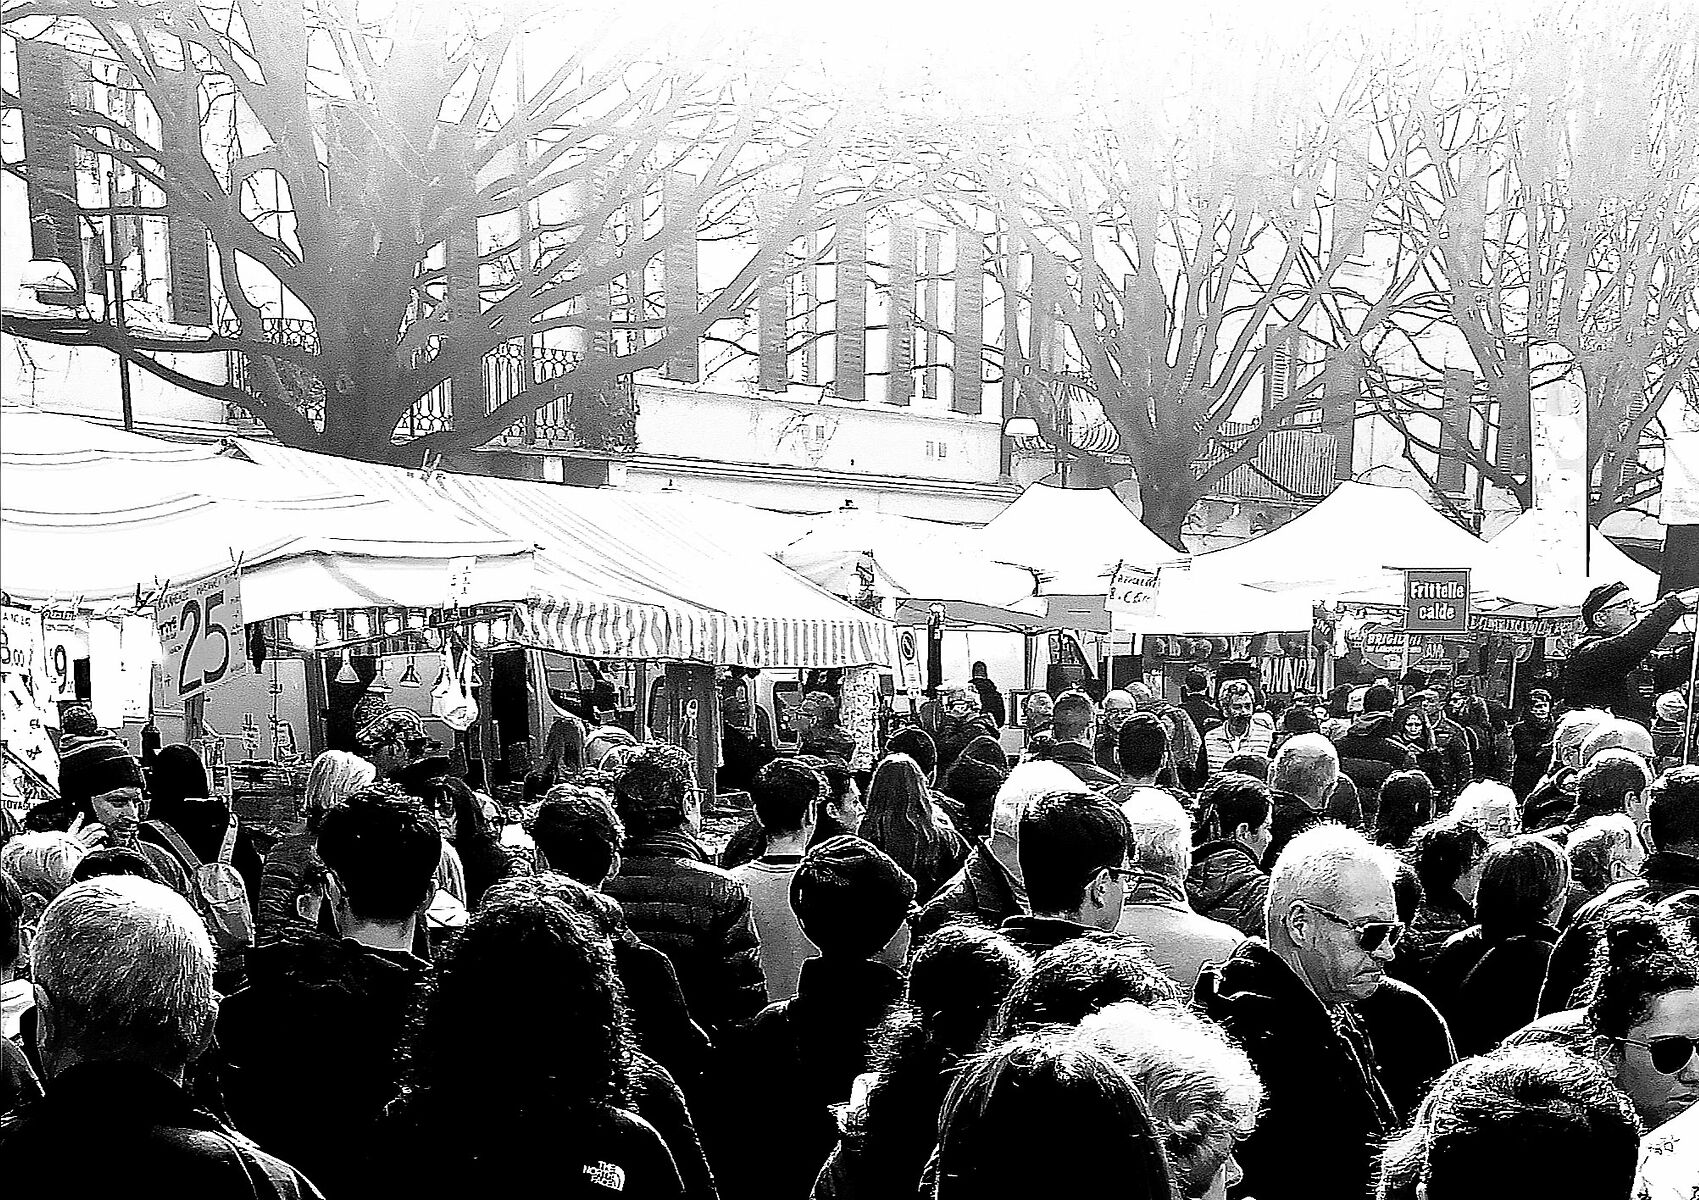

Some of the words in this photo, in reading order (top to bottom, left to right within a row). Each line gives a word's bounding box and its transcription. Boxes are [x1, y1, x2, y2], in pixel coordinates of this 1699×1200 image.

[1410, 581, 1465, 599] Frittelle
[1418, 602, 1456, 620] calde
[179, 590, 229, 696] 25
[583, 1164, 615, 1181] NORTH
[598, 1161, 616, 1173] THE
[590, 1175, 614, 1189] FACE
